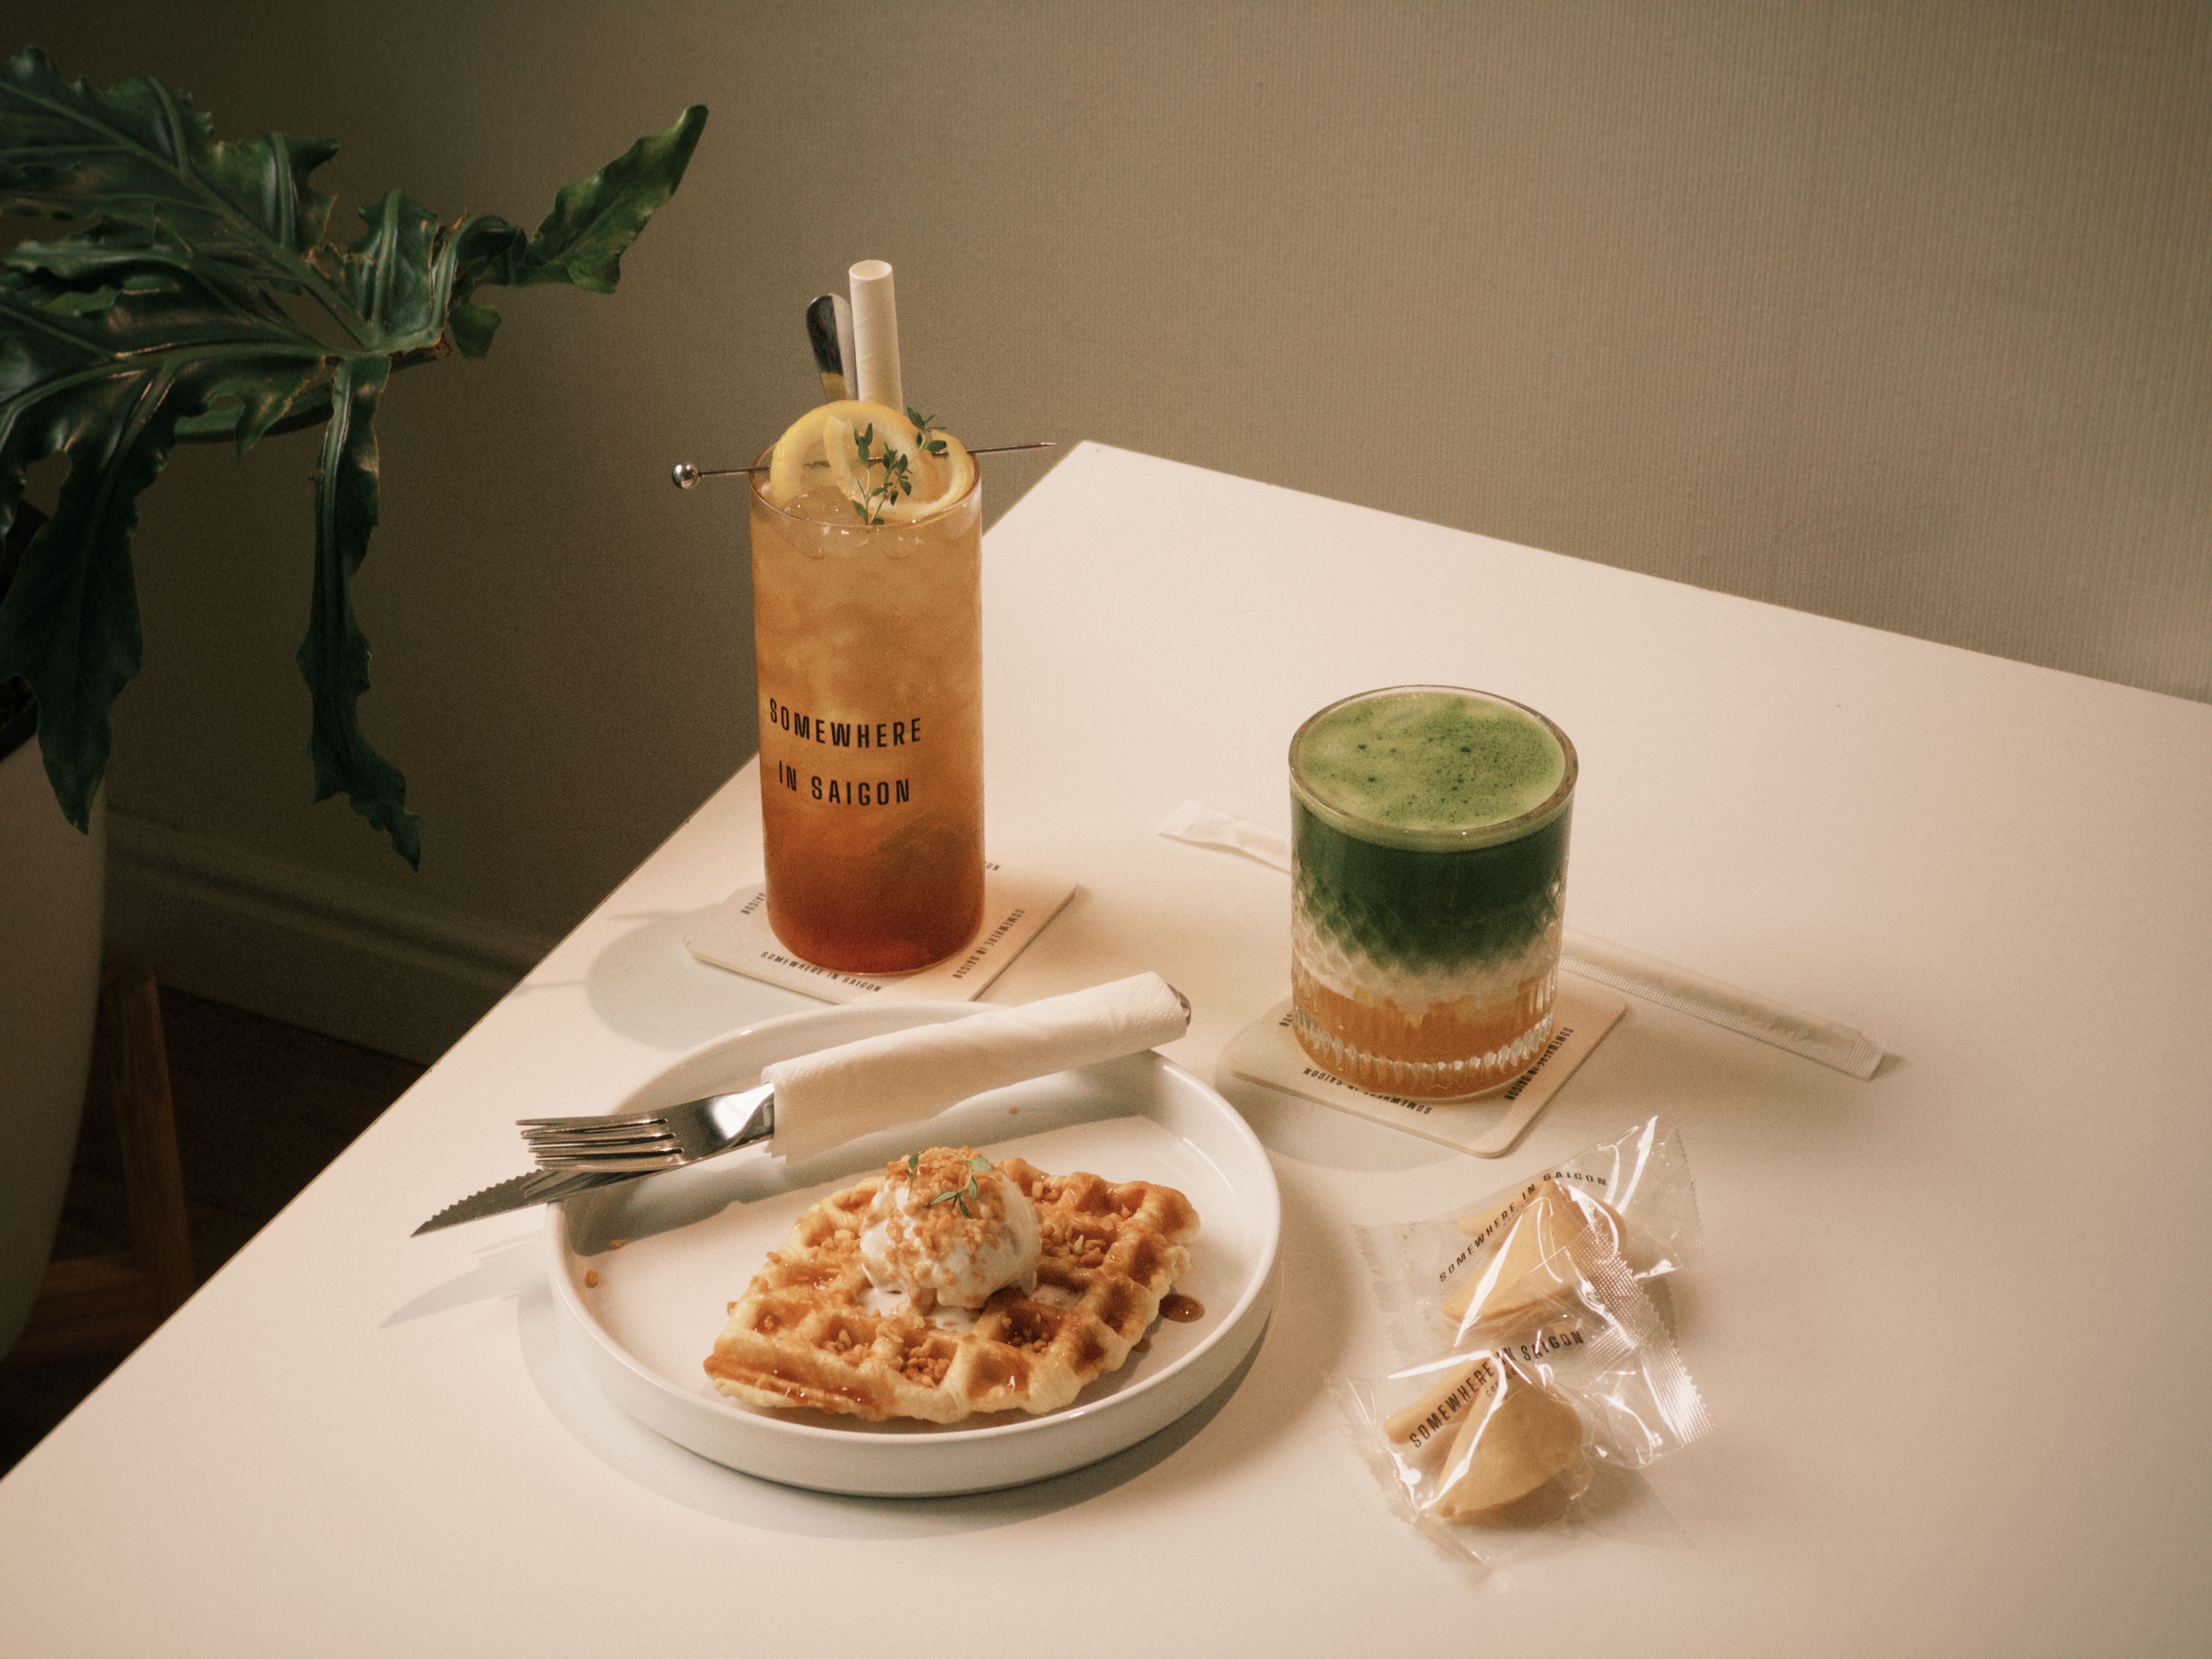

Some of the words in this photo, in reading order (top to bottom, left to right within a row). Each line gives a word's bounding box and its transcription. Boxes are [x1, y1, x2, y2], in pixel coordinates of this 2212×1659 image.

[770, 698, 921, 748] SOMEWHERE
[778, 760, 797, 791] IN
[811, 776, 910, 806] SAIGON
[984, 909, 1025, 946] SOMEWHERE
[952, 956, 980, 979] SAIGON
[976, 947, 989, 955] IN
[760, 951, 824, 975] SOMEWHERE
[826, 972, 839, 980] IN
[842, 977, 882, 992] SAIGON
[1537, 1027, 1574, 1066] SOMEWHERE
[1503, 1075, 1532, 1101] SAIGON
[1527, 1066, 1541, 1075] IN
[1439, 1202, 1515, 1283] SOMEWHERE
[1521, 1183, 1535, 1200] IN
[1543, 1171, 1607, 1186] SAIGON
[1409, 1361, 1496, 1448] SOMEWHERE
